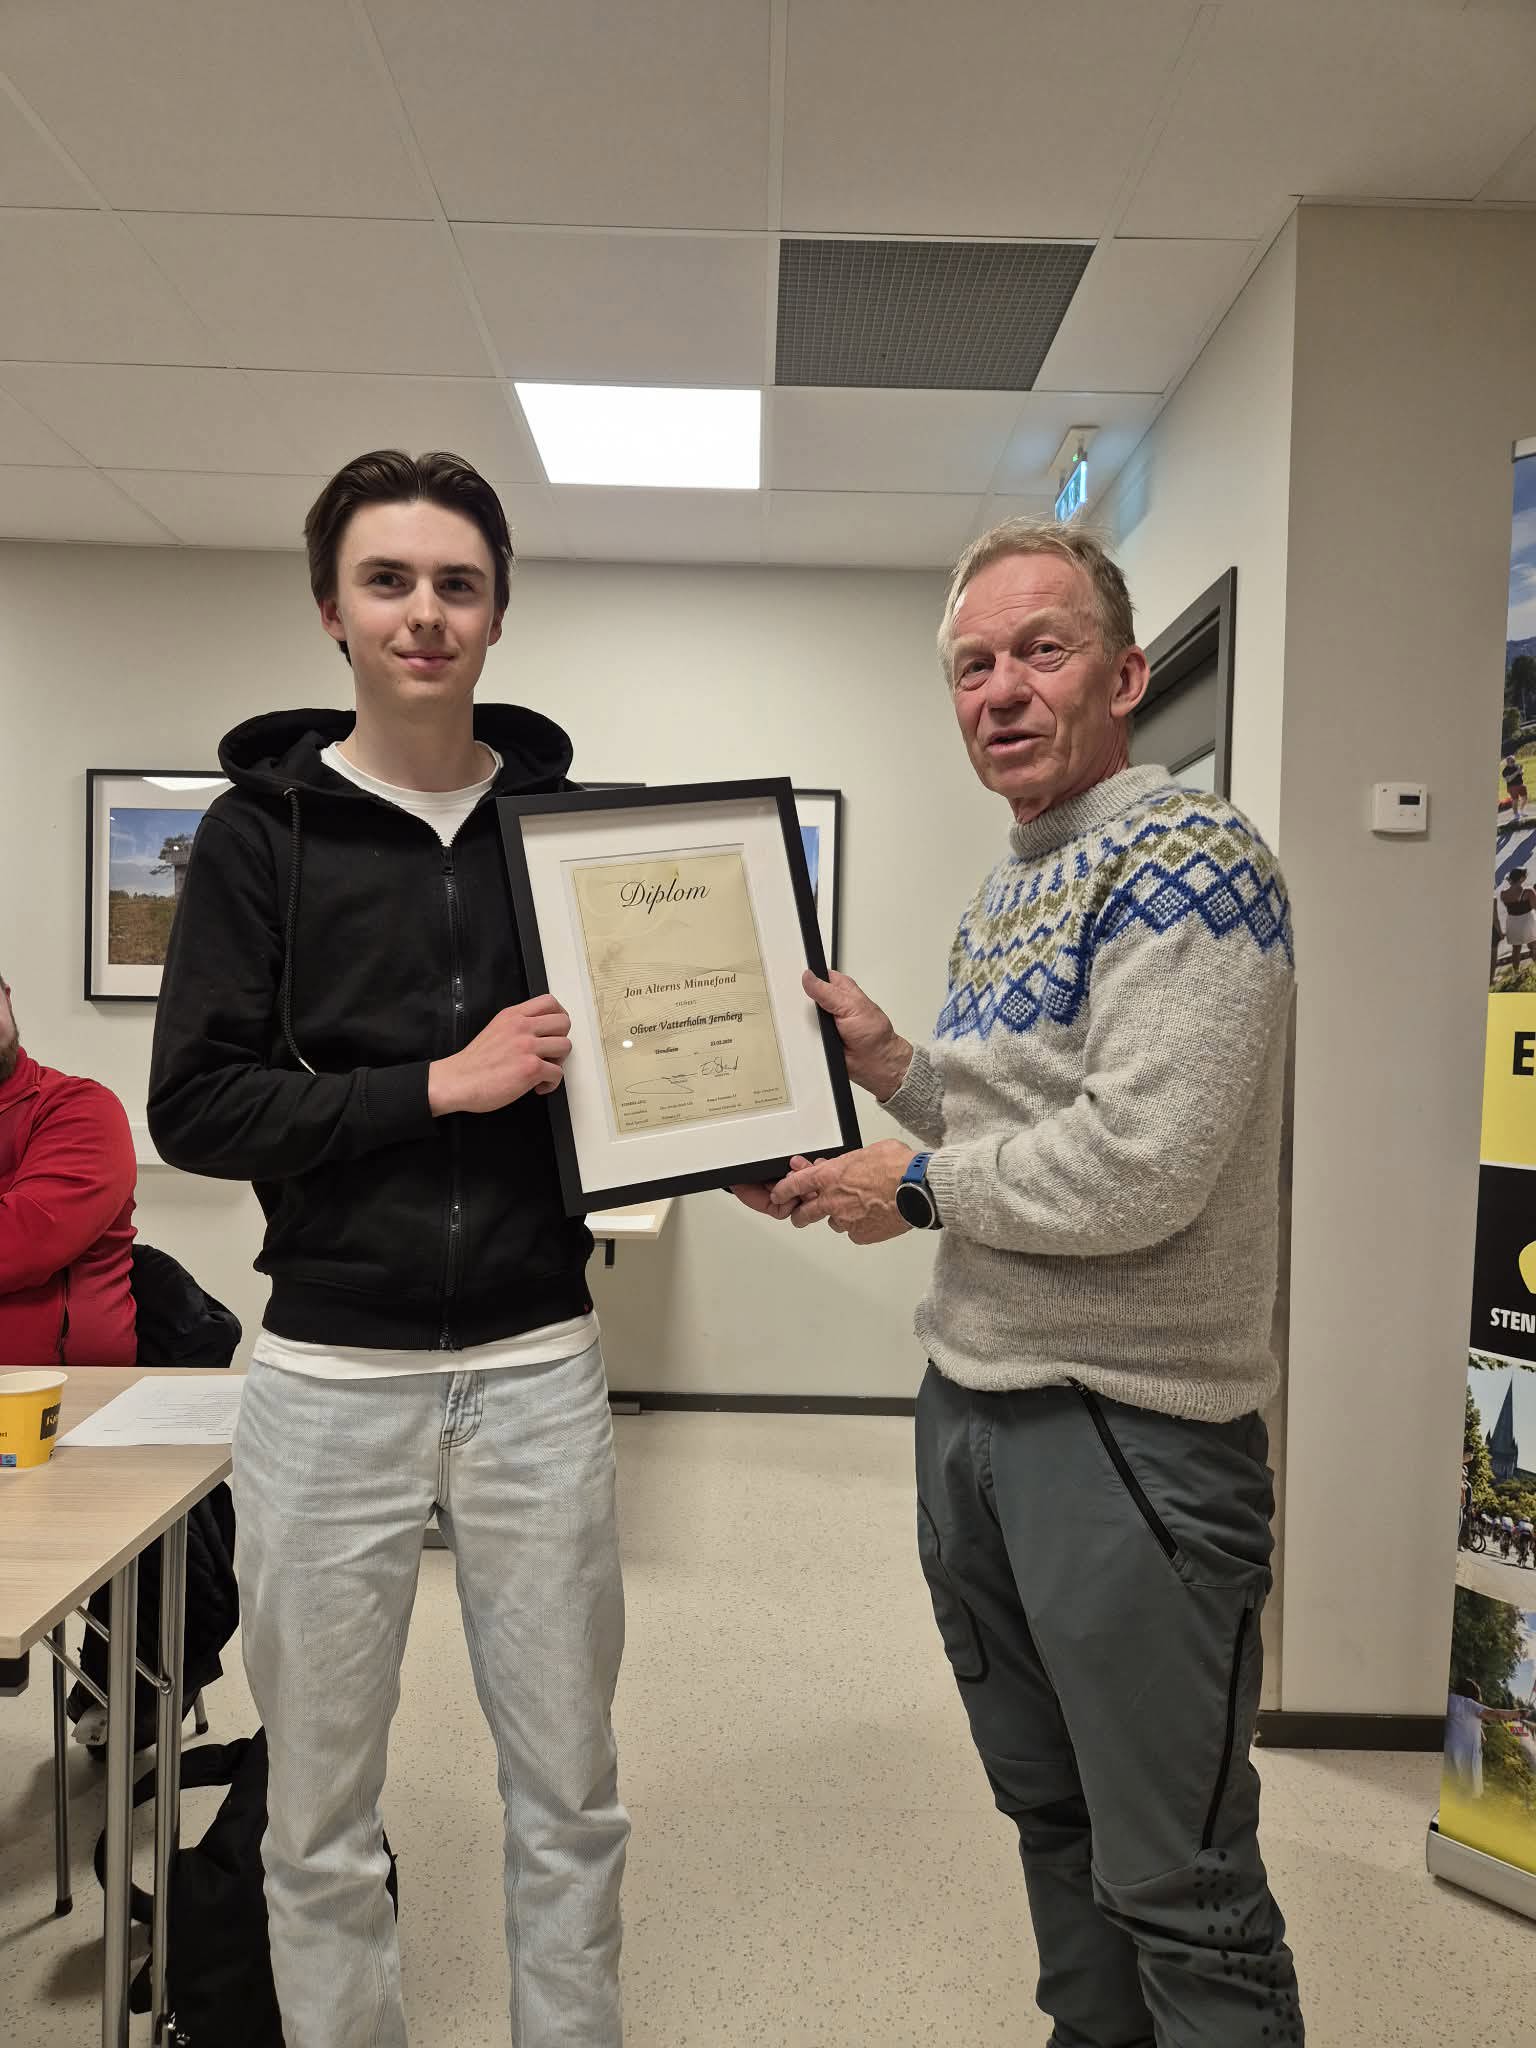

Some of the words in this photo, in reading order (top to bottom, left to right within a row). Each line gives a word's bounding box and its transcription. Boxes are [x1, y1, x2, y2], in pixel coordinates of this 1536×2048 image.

[621, 878, 711, 914] Diplom
[624, 987, 642, 998] Jon
[684, 973, 736, 989] Minnefond
[630, 1024, 658, 1035] Oliver
[659, 1015, 706, 1030] Vatterholm
[708, 1012, 743, 1025] Jernberg
[1490, 1307, 1536, 1333] STEN
